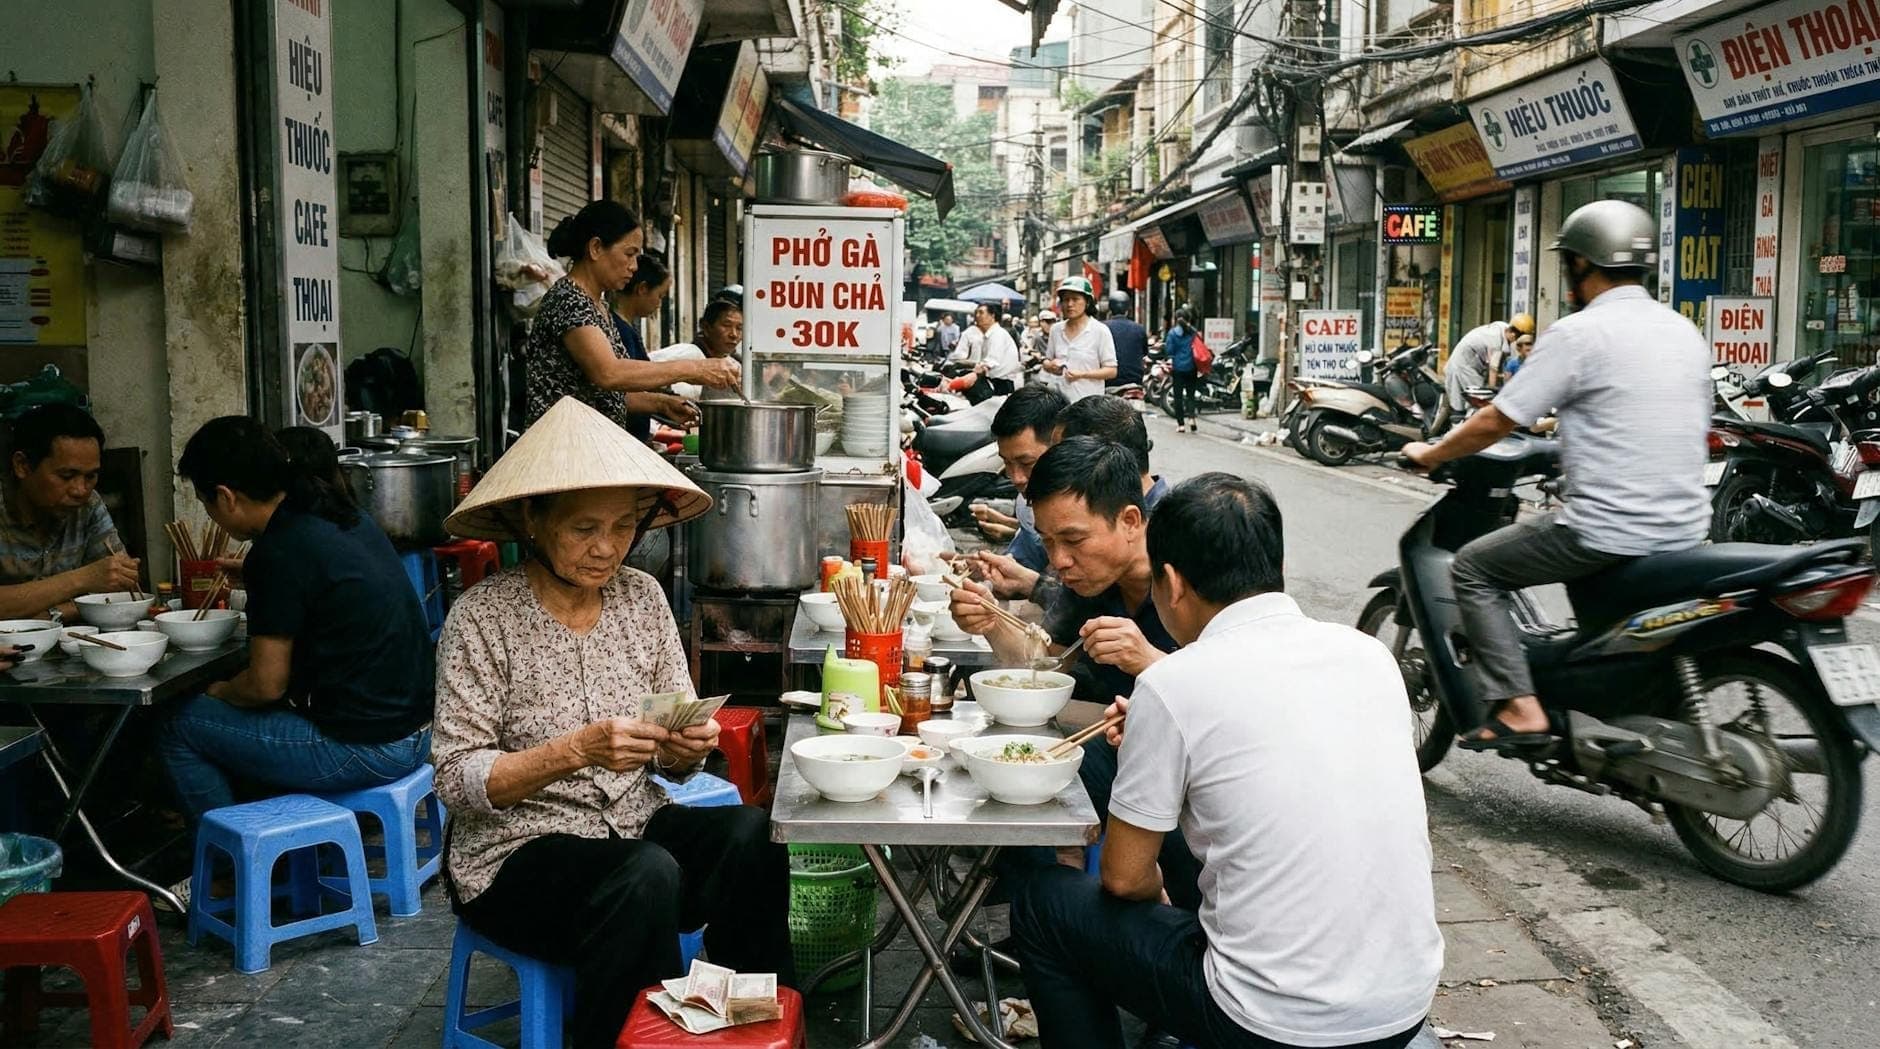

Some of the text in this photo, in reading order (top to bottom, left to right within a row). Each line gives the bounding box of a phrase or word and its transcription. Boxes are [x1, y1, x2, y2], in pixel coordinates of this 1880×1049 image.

[289, 35, 322, 102] HIỆU
[1721, 22, 1792, 82] ĐIỆN
[1504, 97, 1548, 140] HIỆU
[1544, 70, 1612, 126] THUỐC
[285, 111, 331, 175] THUỐC
[294, 198, 329, 248] CAFE
[1386, 210, 1438, 238] CAFÉ
[772, 227, 881, 268] PHỞ GÀ
[293, 276, 334, 332] THOẠI
[770, 273, 886, 310] BÚN CHẢ
[792, 320, 860, 347] 30K
[1305, 315, 1357, 335] CAFÉ
[1721, 303, 1764, 335] ĐIỆN
[1715, 342, 1769, 368] THOẠI
